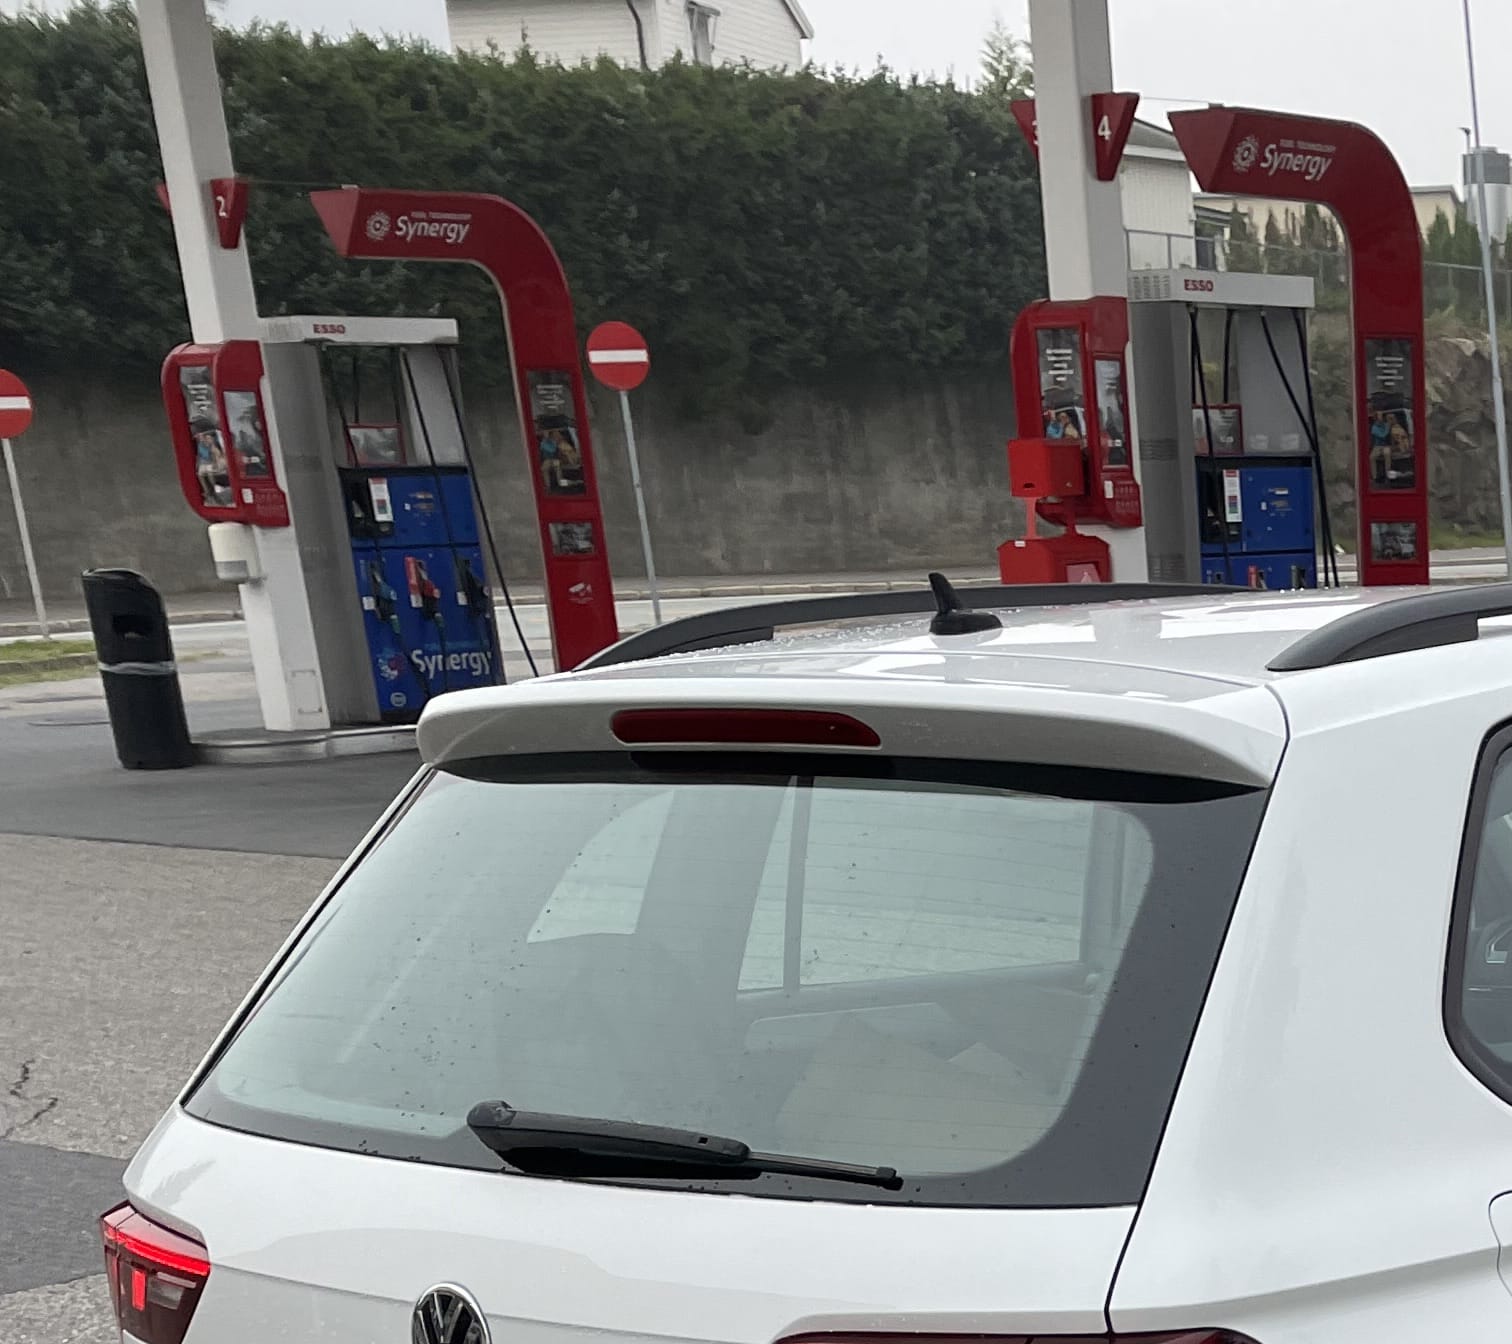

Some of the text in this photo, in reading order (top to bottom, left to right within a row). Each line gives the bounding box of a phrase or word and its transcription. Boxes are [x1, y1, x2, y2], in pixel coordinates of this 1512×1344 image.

[1097, 115, 1111, 140] 4
[1260, 143, 1332, 181] Synergy
[216, 195, 228, 217] 2
[395, 215, 470, 243] Synergy
[1184, 279, 1214, 292] ESSO
[313, 323, 346, 334] ESSO
